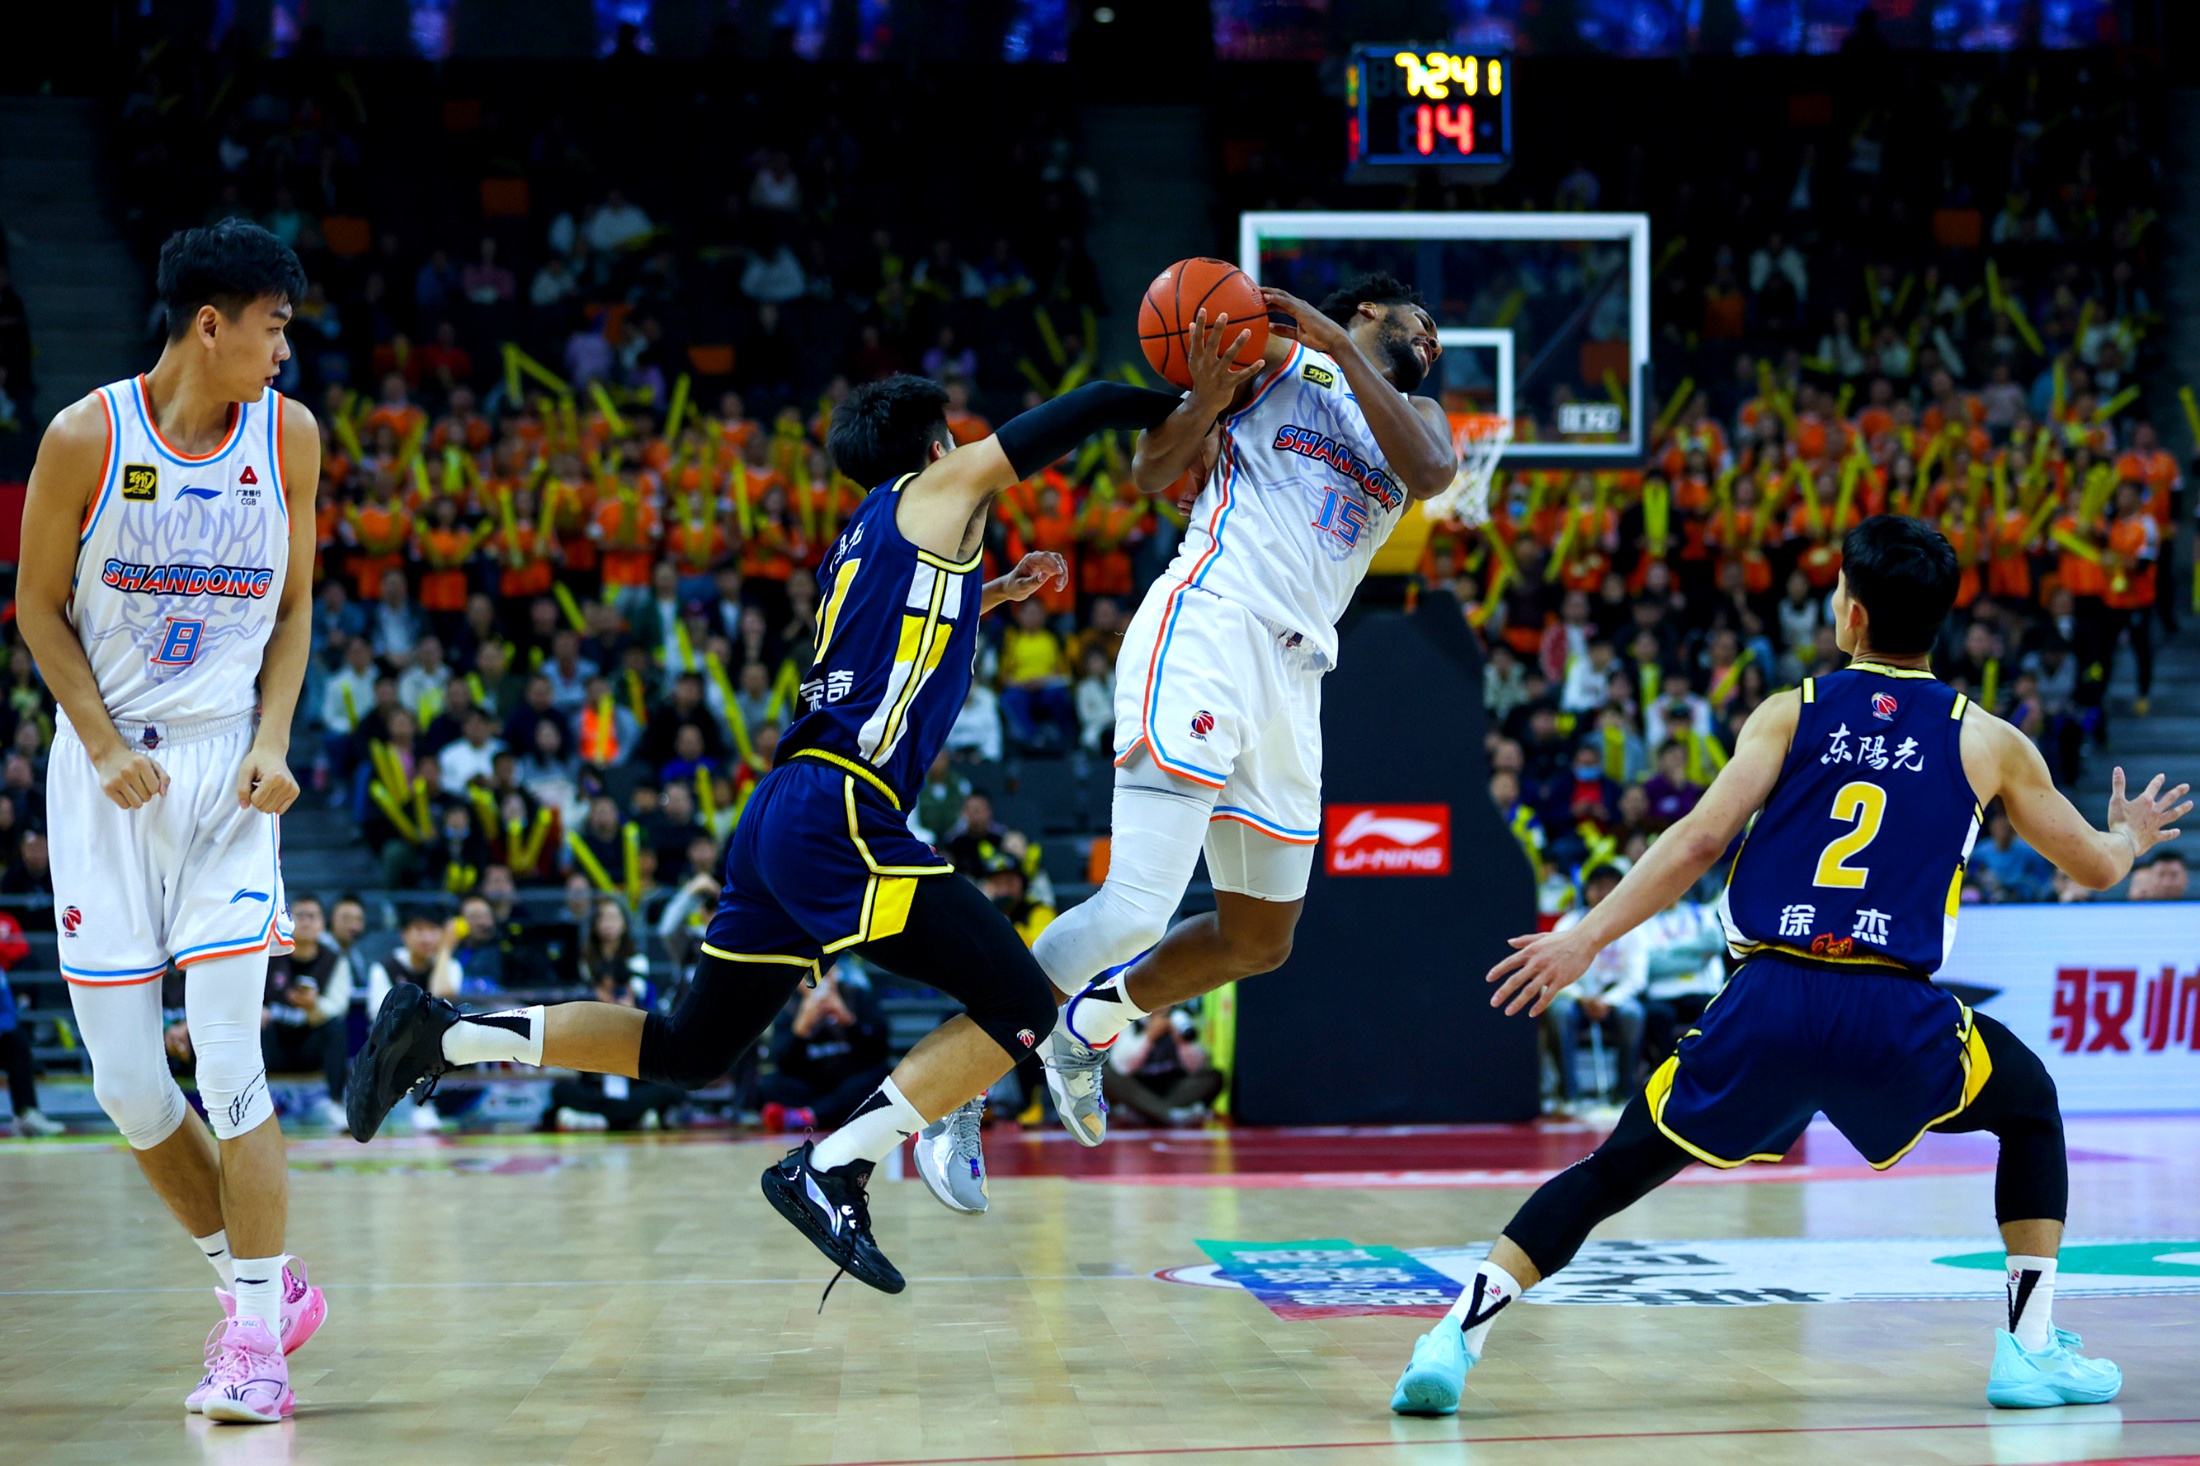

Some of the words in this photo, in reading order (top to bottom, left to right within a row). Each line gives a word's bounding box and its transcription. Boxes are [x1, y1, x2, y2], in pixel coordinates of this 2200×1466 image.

[1417, 104, 1474, 155] 14
[1272, 424, 1404, 514] SHANDONG
[241, 497, 257, 506] CGB
[1312, 486, 1368, 548] 15
[102, 558, 274, 600] SHANDONG
[151, 616, 206, 666] 8
[1333, 847, 1443, 871] LI-NING
[1812, 781, 1887, 889] 2
